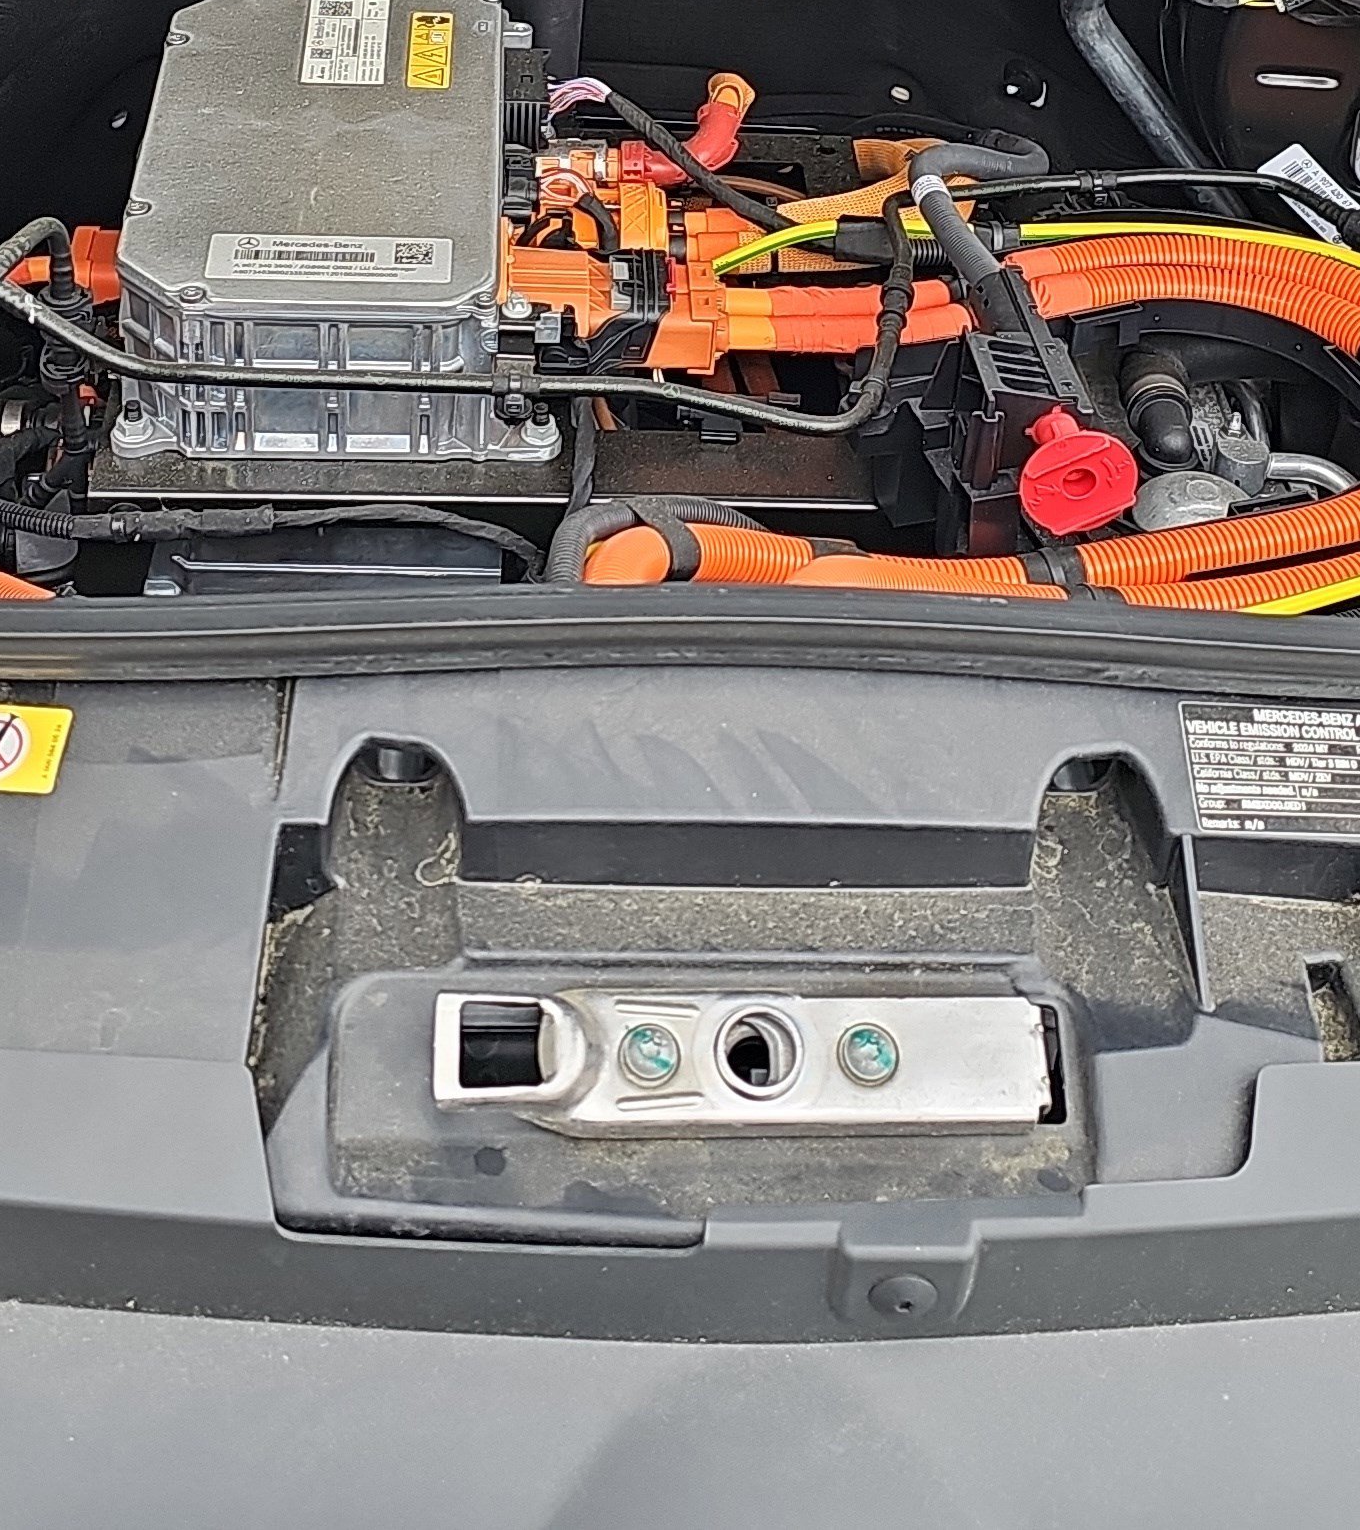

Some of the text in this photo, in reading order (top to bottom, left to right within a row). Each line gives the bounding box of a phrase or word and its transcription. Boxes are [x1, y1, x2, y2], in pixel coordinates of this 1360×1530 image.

[1319, 177, 1332, 188] 907
[1331, 188, 1343, 201] 430
[272, 240, 364, 249] Mercedes-Benz
[1253, 708, 1355, 727] MERCEDES-BENZ
[1186, 719, 1240, 736] VEHICLE
[1240, 722, 1301, 738] EMISSION
[1301, 724, 1360, 741] CONTROL
[1189, 737, 1229, 749] Conforms
[1229, 739, 1239, 749] to
[1191, 751, 1209, 763] U.S.
[1210, 753, 1227, 764] EPA
[1193, 767, 1233, 779] California
[1315, 772, 1332, 783] ZEV
[1195, 782, 1210, 793] No
